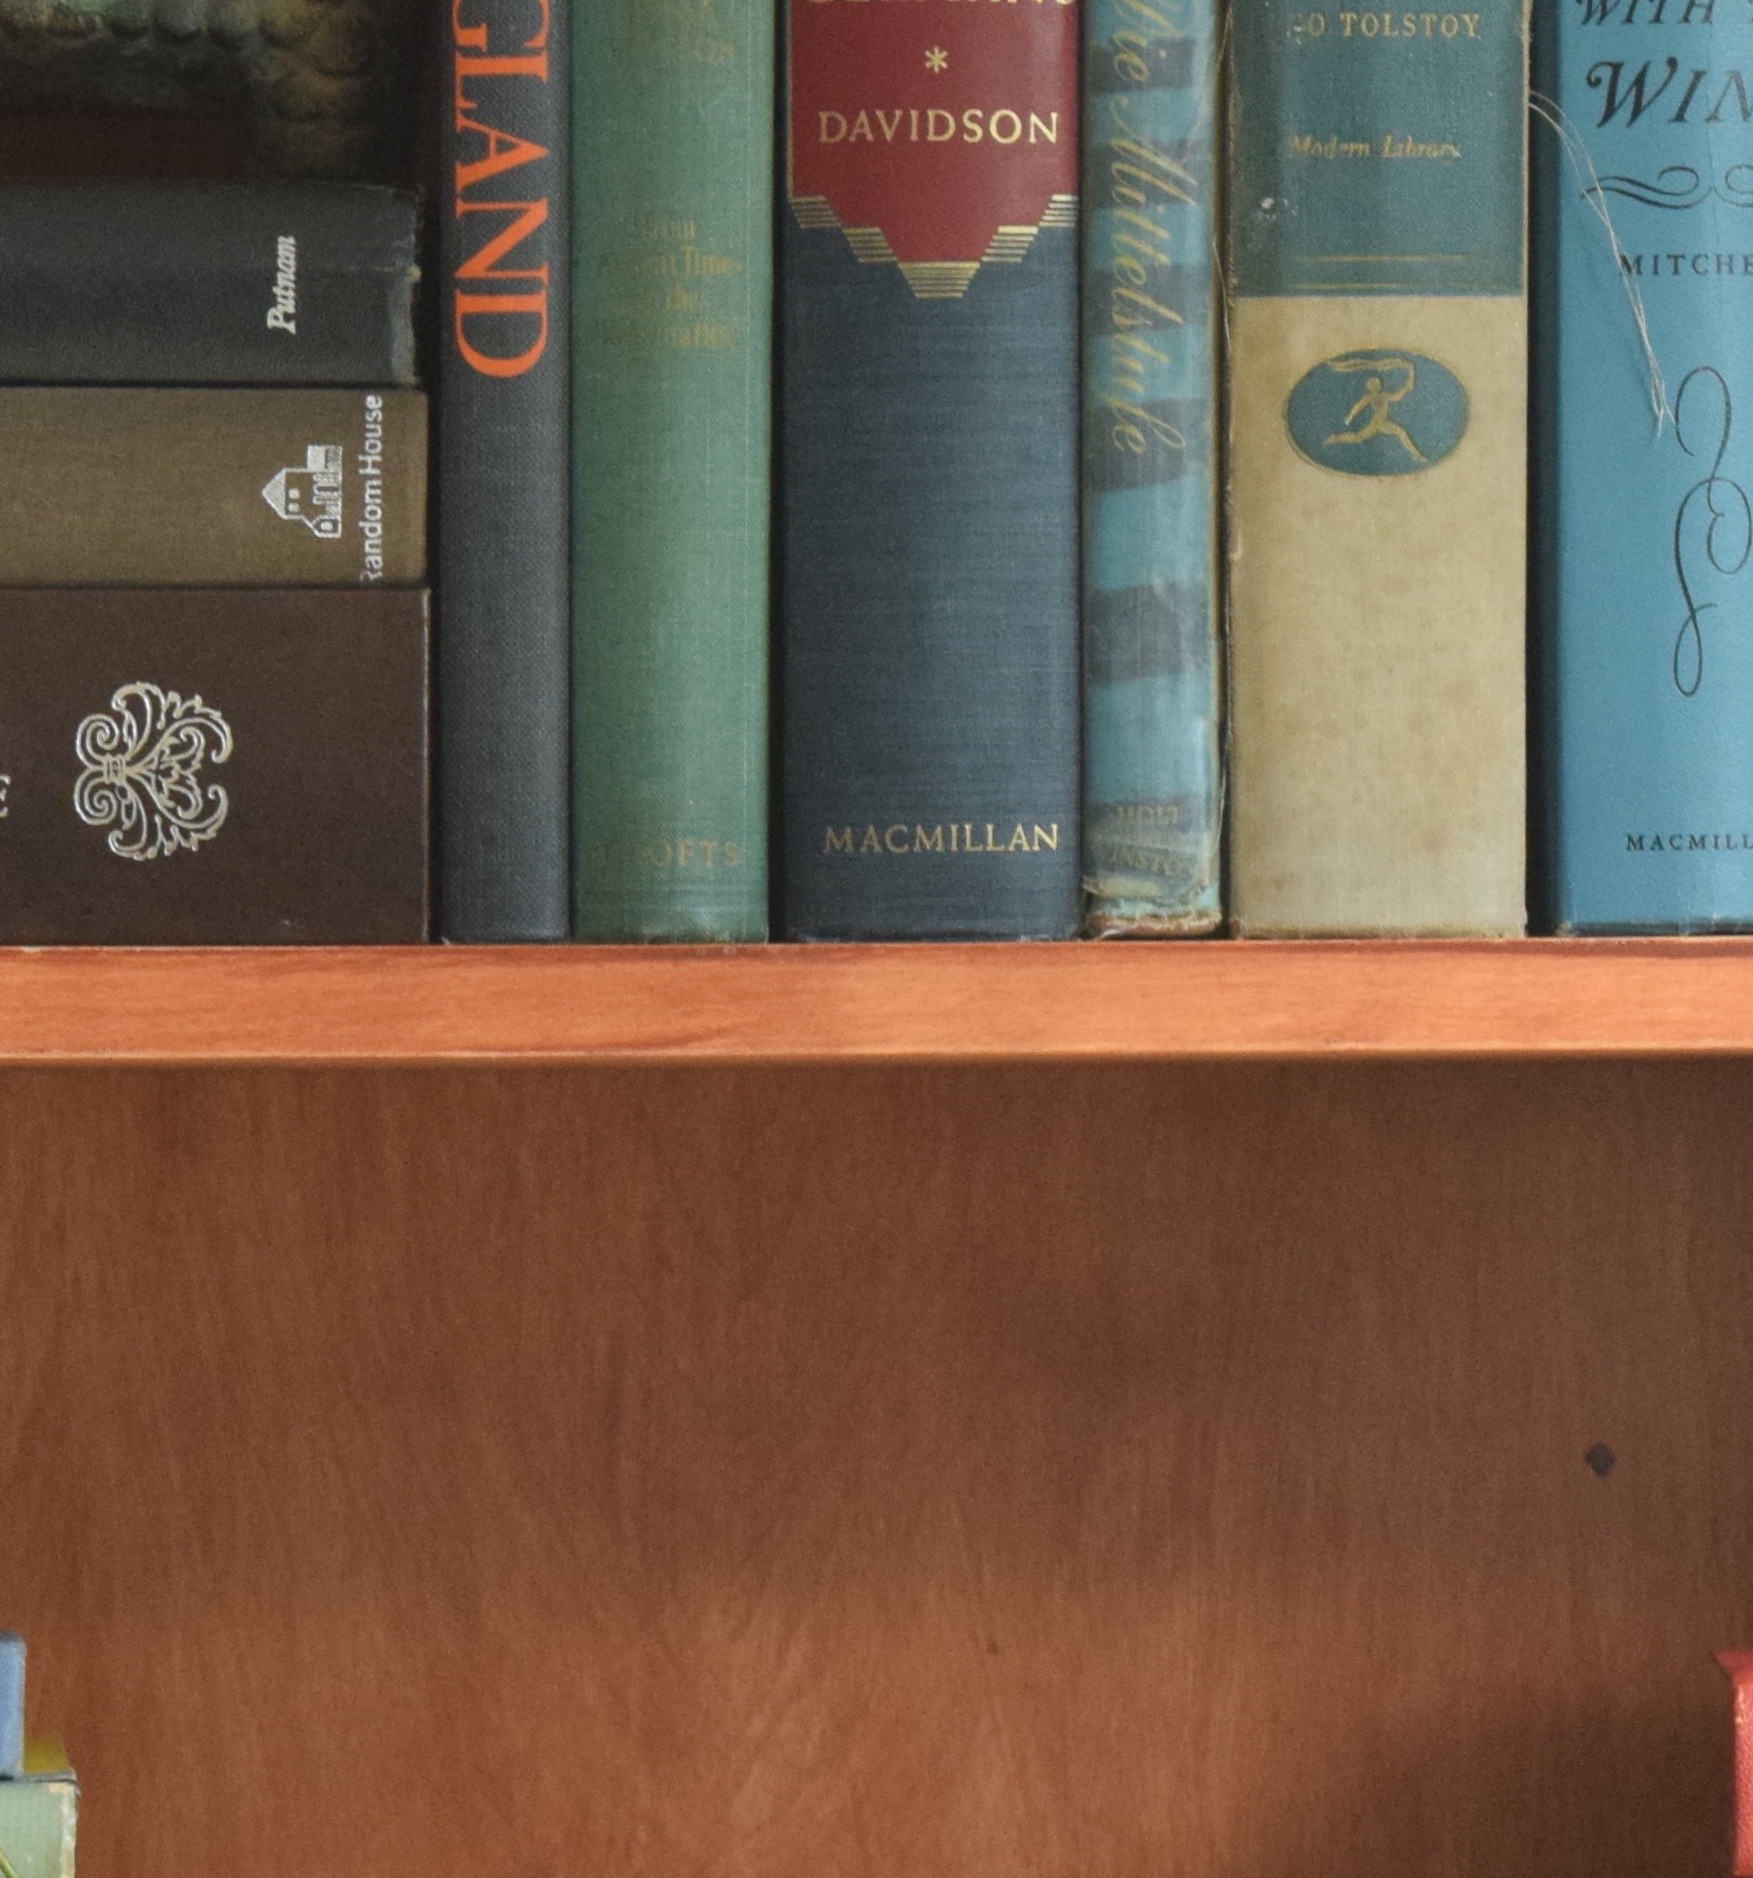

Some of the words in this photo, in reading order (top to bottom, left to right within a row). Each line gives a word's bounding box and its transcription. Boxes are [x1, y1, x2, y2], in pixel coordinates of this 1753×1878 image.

[1340, 12, 1480, 38] TOLSTOY
[818, 109, 1060, 145] DAVIDSON
[1289, 134, 1371, 160] Modern
[266, 235, 296, 335] Putnam
[1108, 98, 1199, 457] Mittelstufe
[358, 394, 384, 475] House
[823, 822, 1060, 855] MACMILLAN
